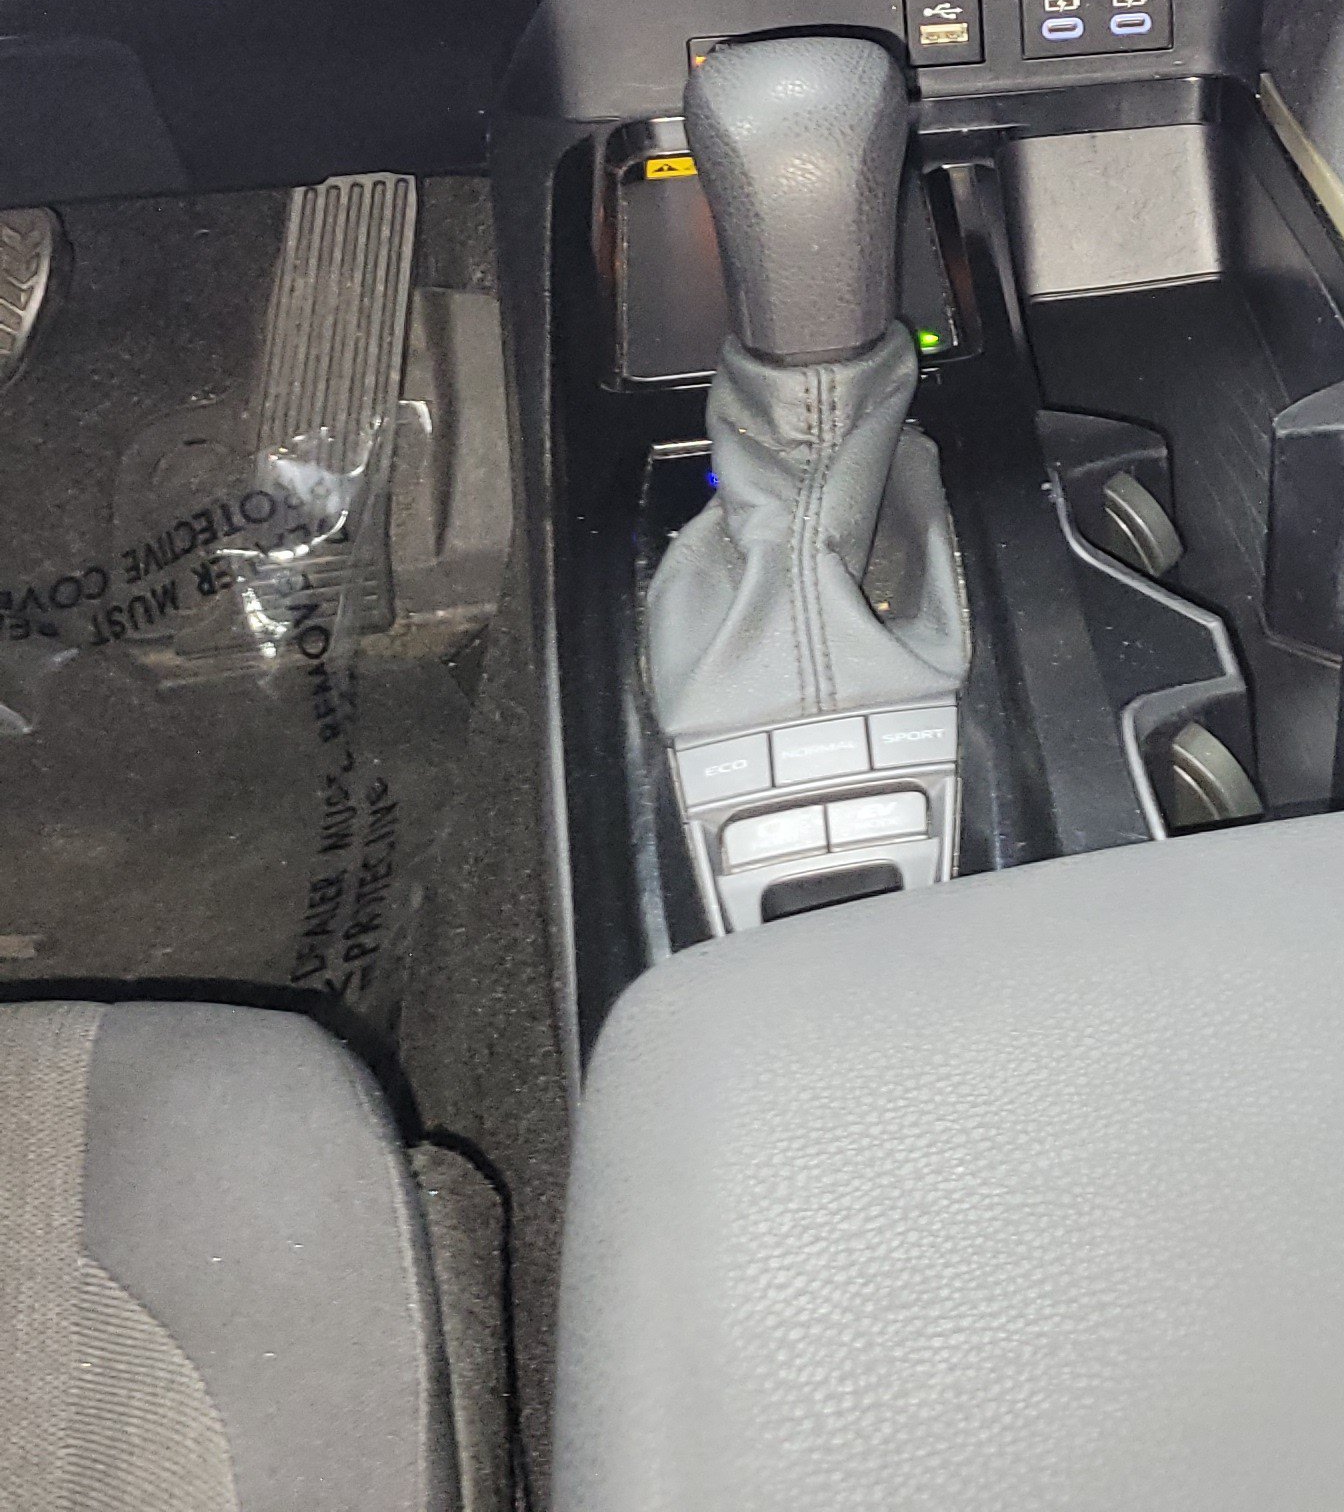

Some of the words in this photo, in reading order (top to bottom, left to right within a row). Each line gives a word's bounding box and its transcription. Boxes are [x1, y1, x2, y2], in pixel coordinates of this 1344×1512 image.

[91, 578, 181, 646] MUST
[882, 728, 946, 743] SPORT
[704, 759, 748, 777] ECO
